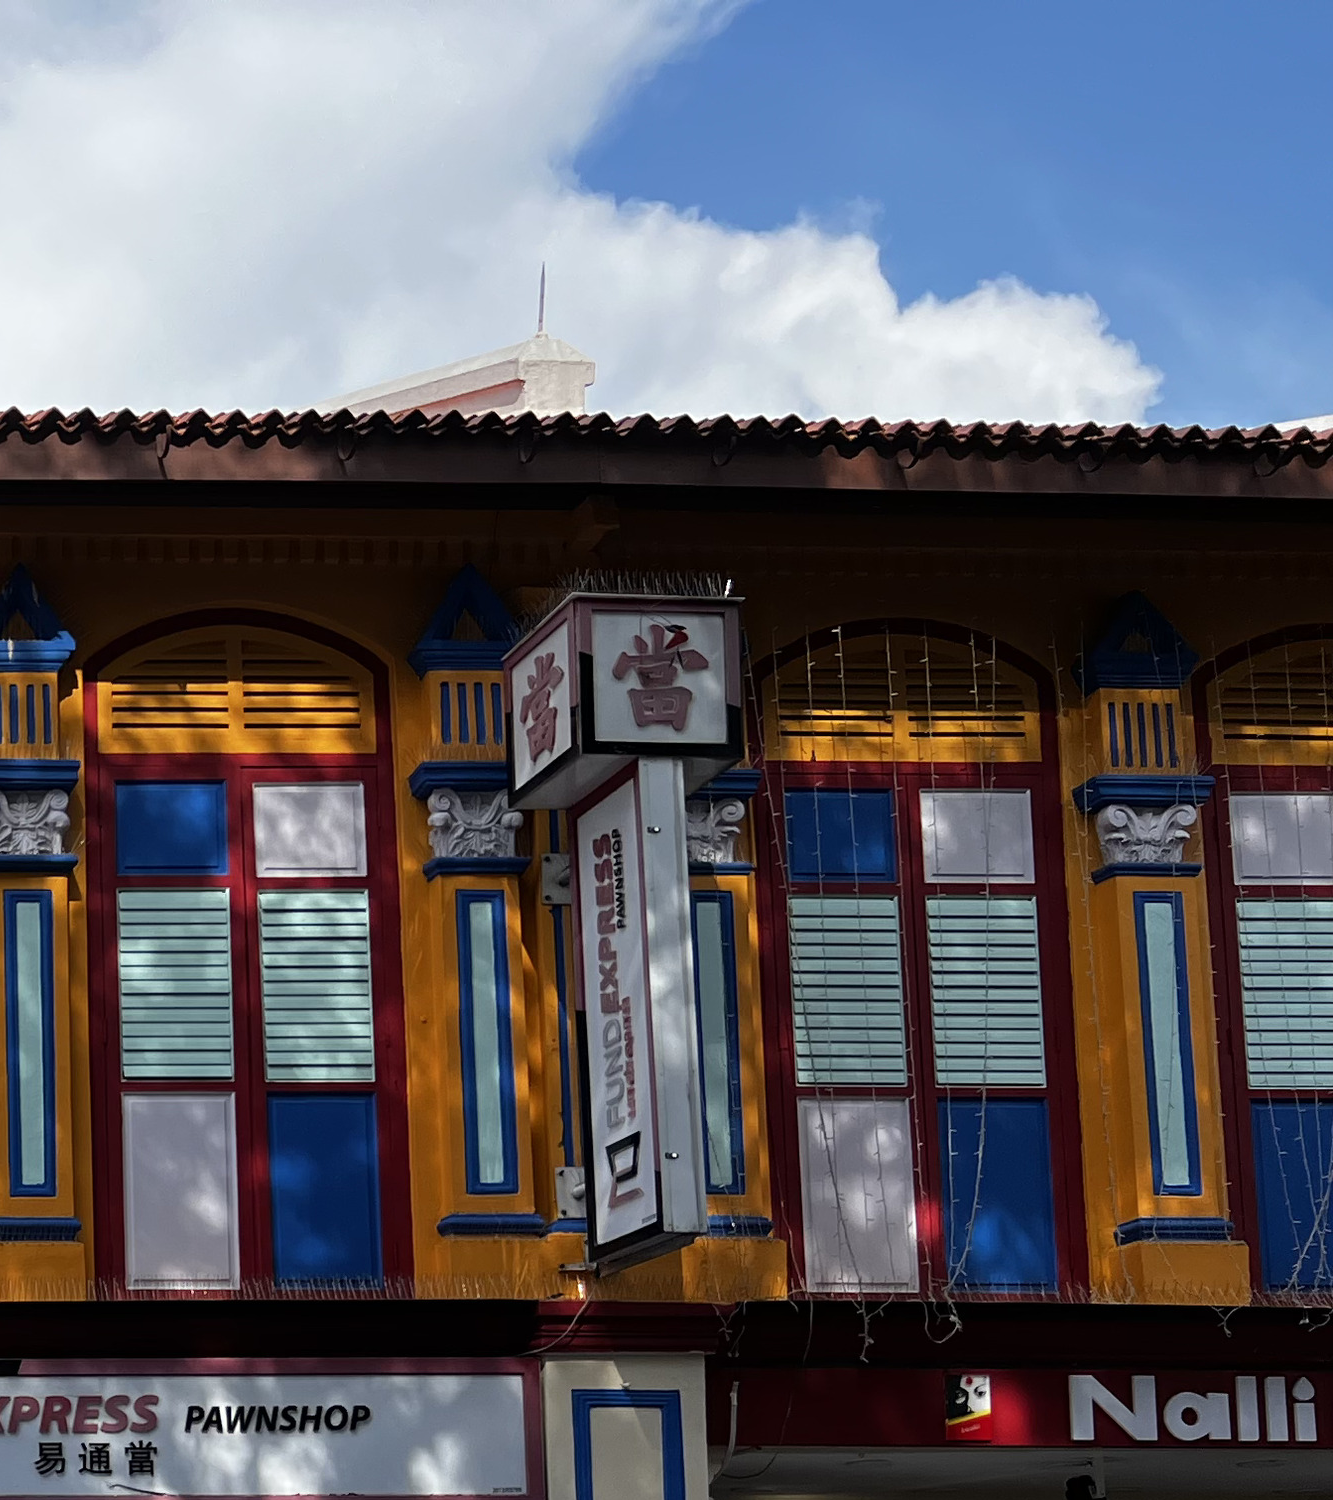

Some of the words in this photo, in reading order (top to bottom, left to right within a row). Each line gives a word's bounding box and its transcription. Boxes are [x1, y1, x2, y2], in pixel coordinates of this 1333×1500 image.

[610, 826, 627, 929] PAWNSHOP
[184, 1404, 372, 1434] PAWNSHOP
[1068, 1374, 1318, 1442] Nalli
[34, 1440, 159, 1477] 易通當
